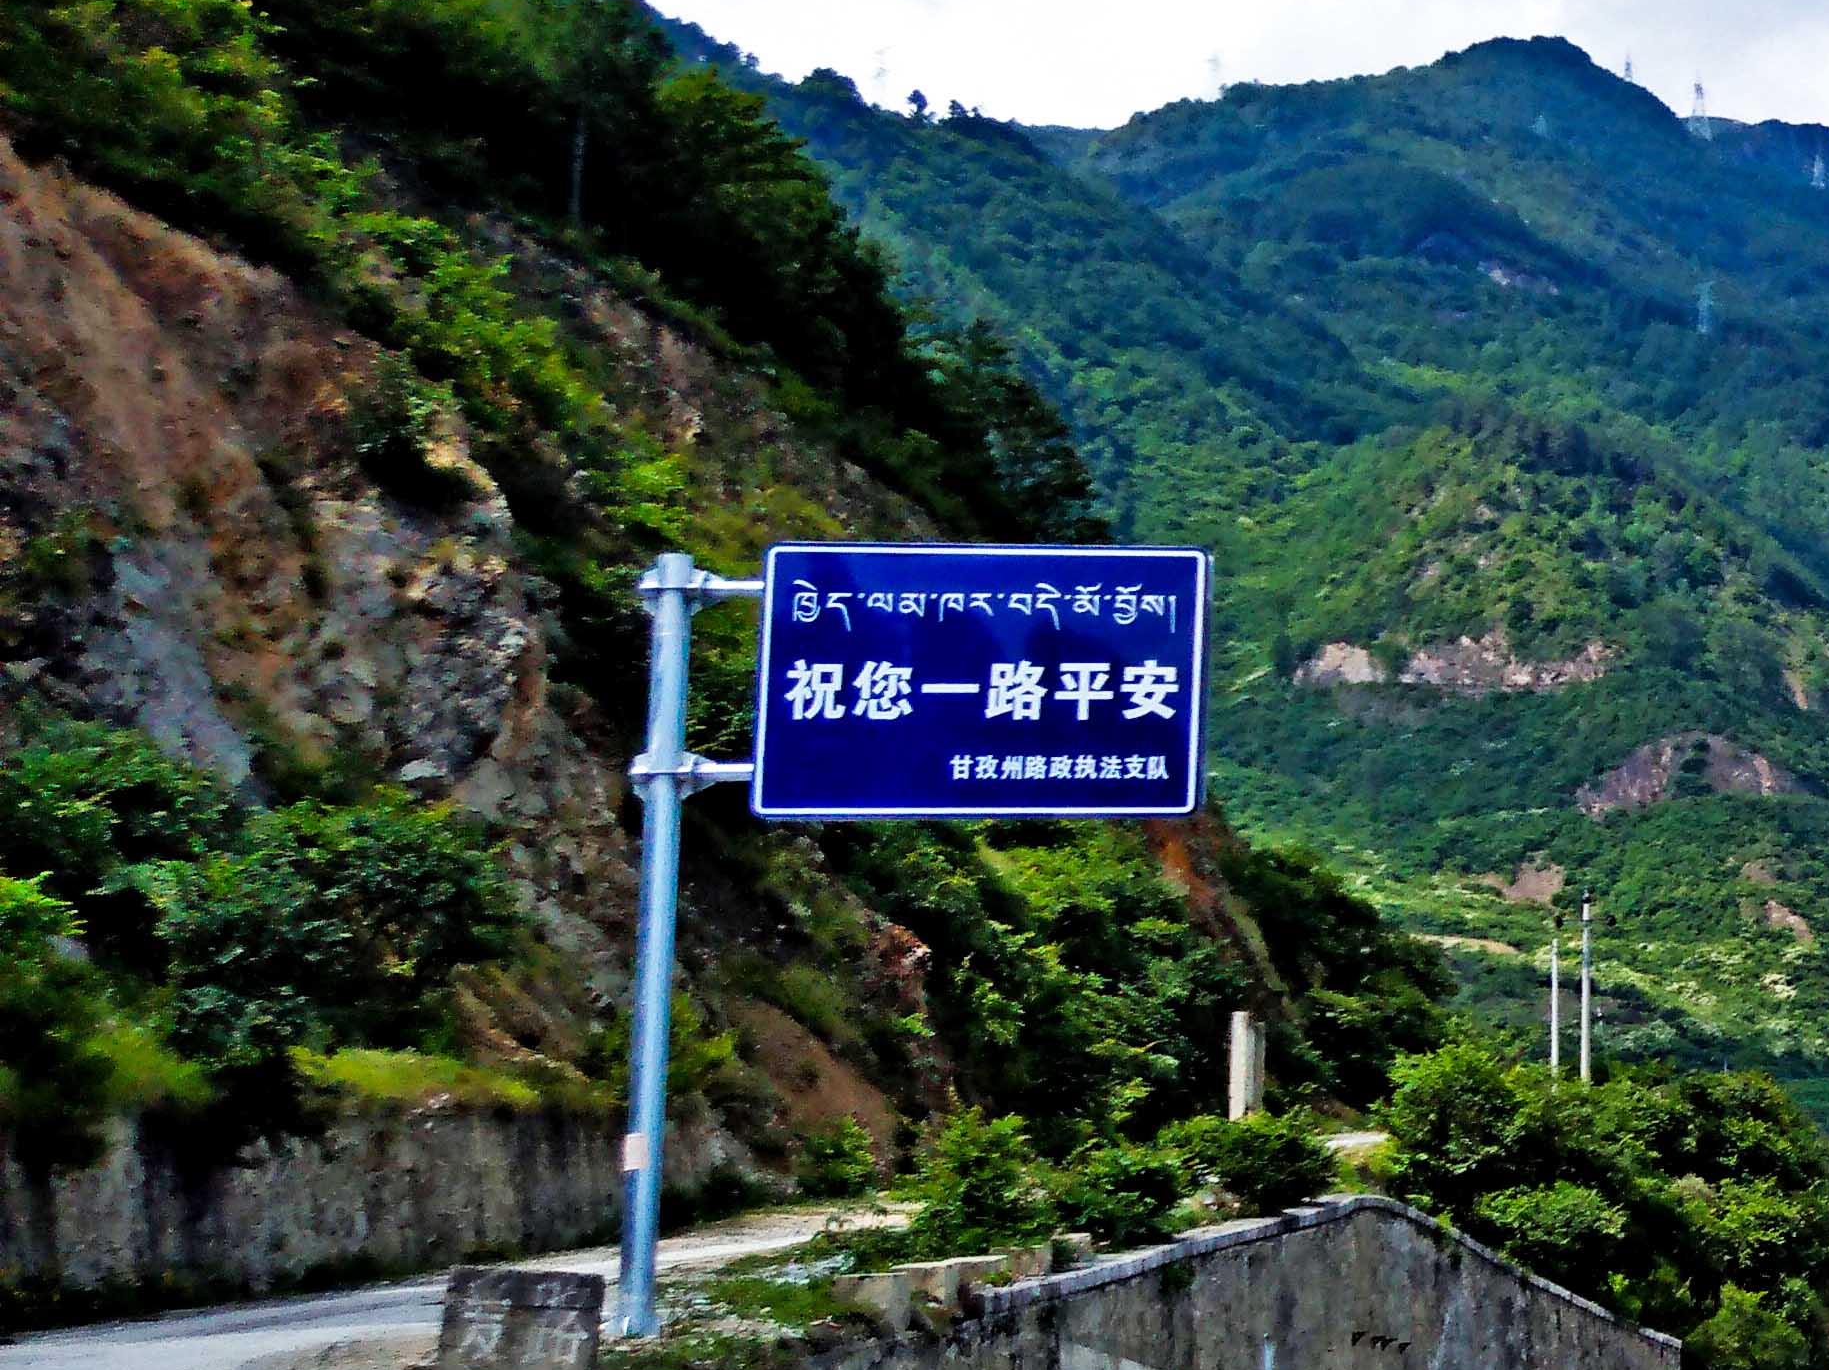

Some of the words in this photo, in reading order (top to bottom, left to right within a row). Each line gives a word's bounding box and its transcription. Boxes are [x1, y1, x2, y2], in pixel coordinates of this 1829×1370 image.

[783, 659, 1180, 721] 祝您一路平安
[949, 754, 1170, 780] 甘孜州路政执法支队
